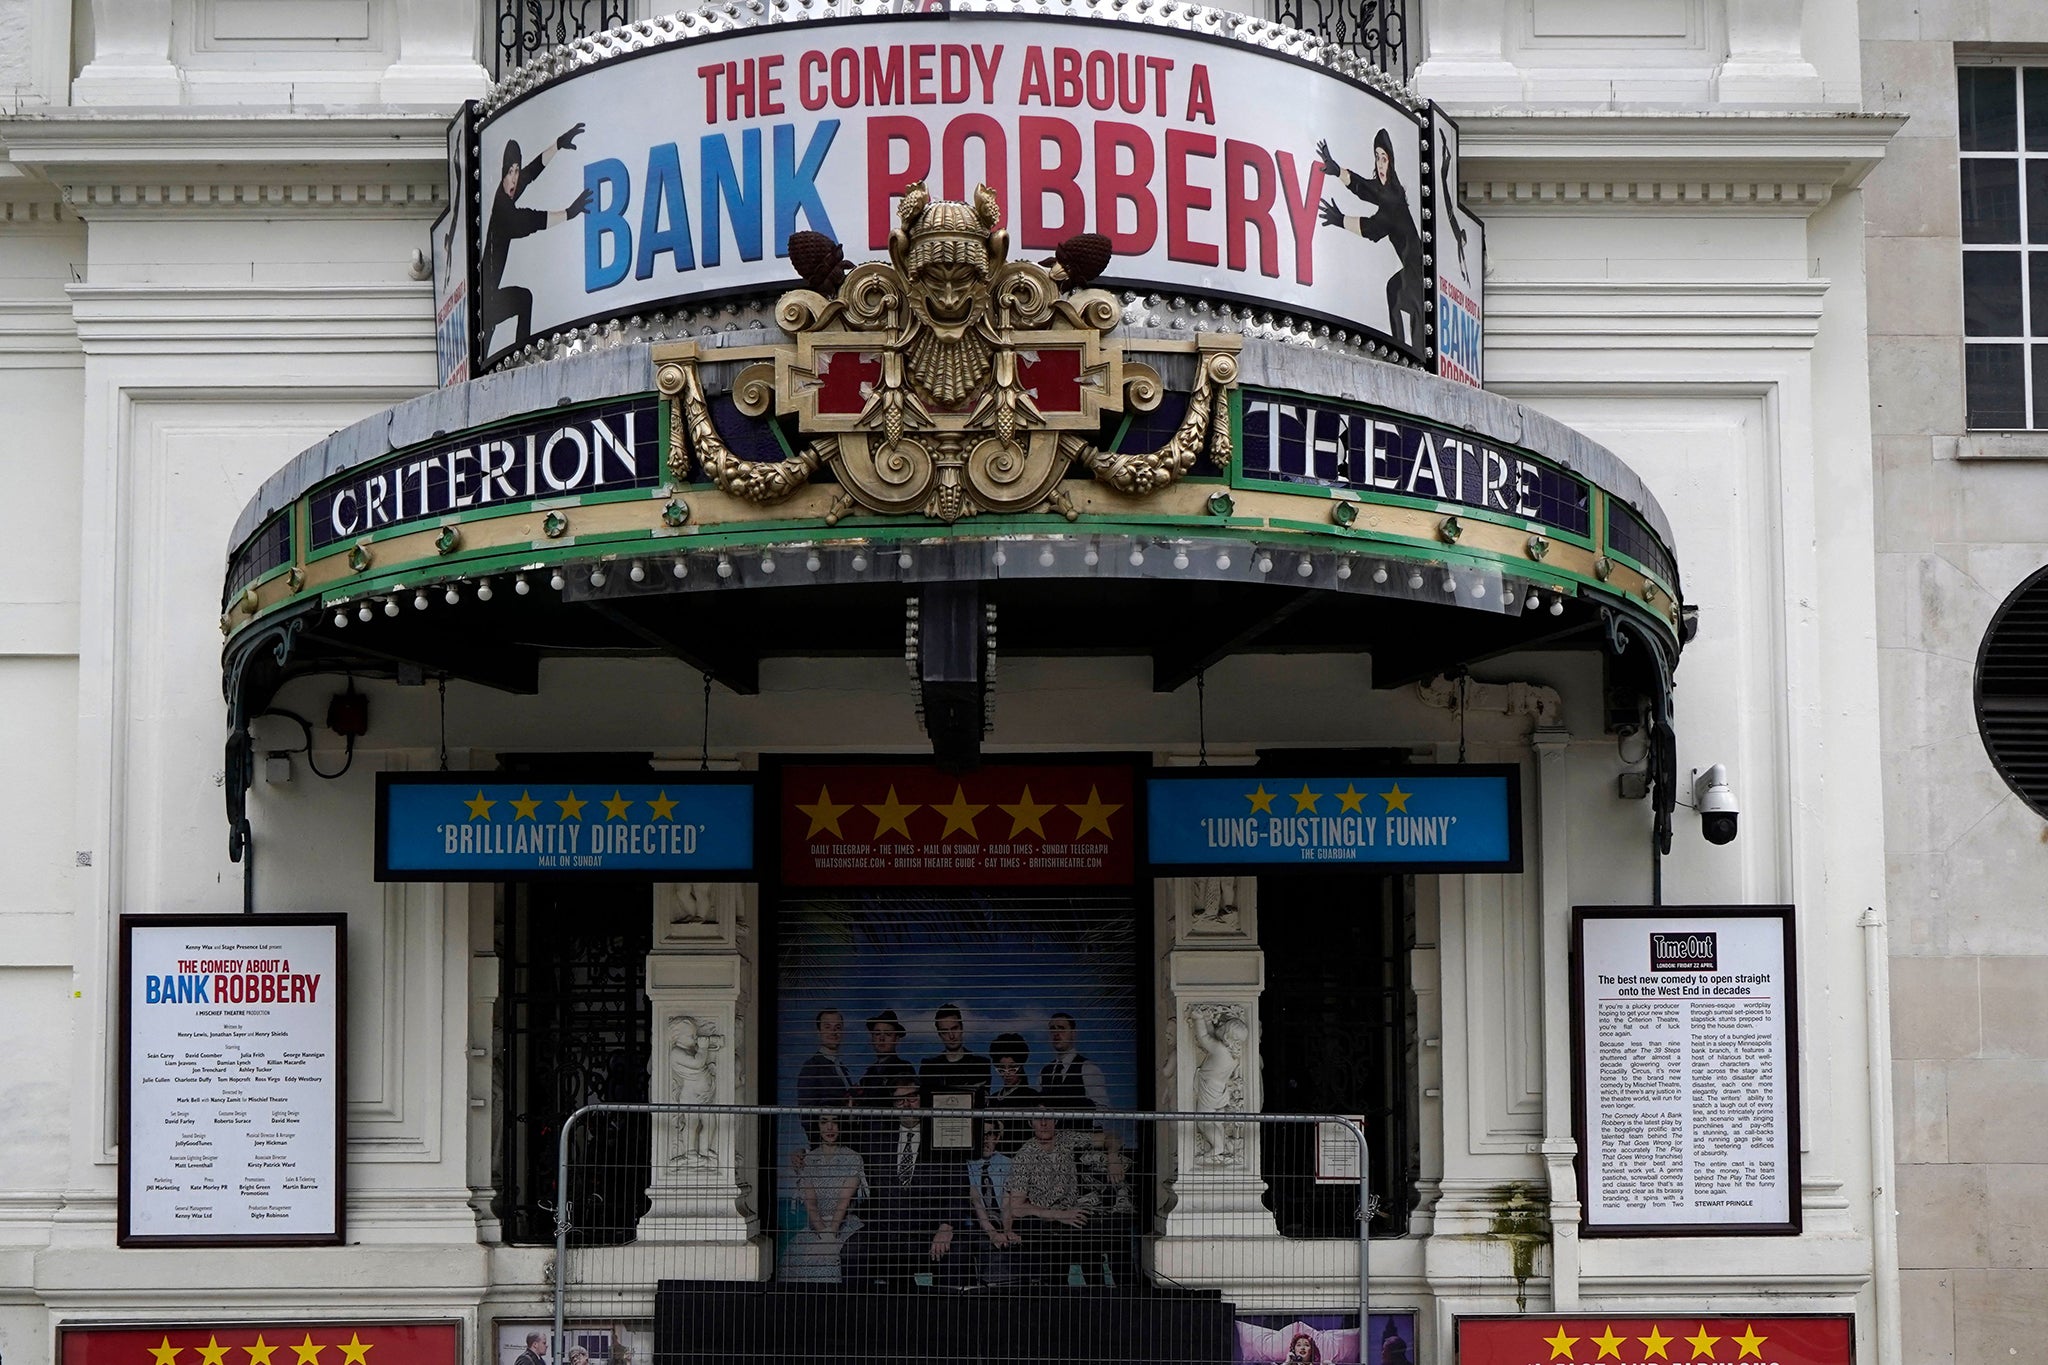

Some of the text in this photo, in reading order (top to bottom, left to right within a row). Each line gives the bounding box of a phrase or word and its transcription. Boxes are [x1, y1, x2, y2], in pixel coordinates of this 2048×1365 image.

[698, 44, 1216, 125] THE COMEDY ABOUT A
[584, 113, 1325, 294] BANK ROBBERY
[438, 296, 467, 387] BANK
[1440, 294, 1480, 380] BANK
[331, 412, 638, 537] CRITERION
[1247, 401, 1541, 518] THEATRE
[436, 824, 705, 854] ‘BRILLIANTLY DIRECTED’
[1201, 816, 1457, 847] ‘LUNG-BUSTINGLY FUNNY’
[539, 856, 602, 866] MAIL ON SUNDAY
[811, 844, 1108, 855] DAILY TELEGRAPH THE TIMES MAIL ON SUNDAY RADIO TIMES SUNDAY TELEGRAPH
[815, 857, 1102, 868] WHATSONSTAGE.COM BRITISH THEATRE GUIDE GAY TIMES BRITISHTHEATRE.COM
[1301, 848, 1356, 859] THE GUARDIAN
[1654, 935, 1713, 958] Time Out
[178, 960, 290, 973] THE COMEDY ABOUT A
[1599, 975, 1614, 984] The
[1618, 975, 1637, 984] best
[1661, 974, 1696, 985] comedy
[1699, 974, 1708, 983] to
[1710, 976, 1732, 985] open
[1735, 974, 1770, 985] straight
[146, 974, 320, 1004] BANK ROBBERY
[1618, 985, 1750, 995] onto the West End in decades
